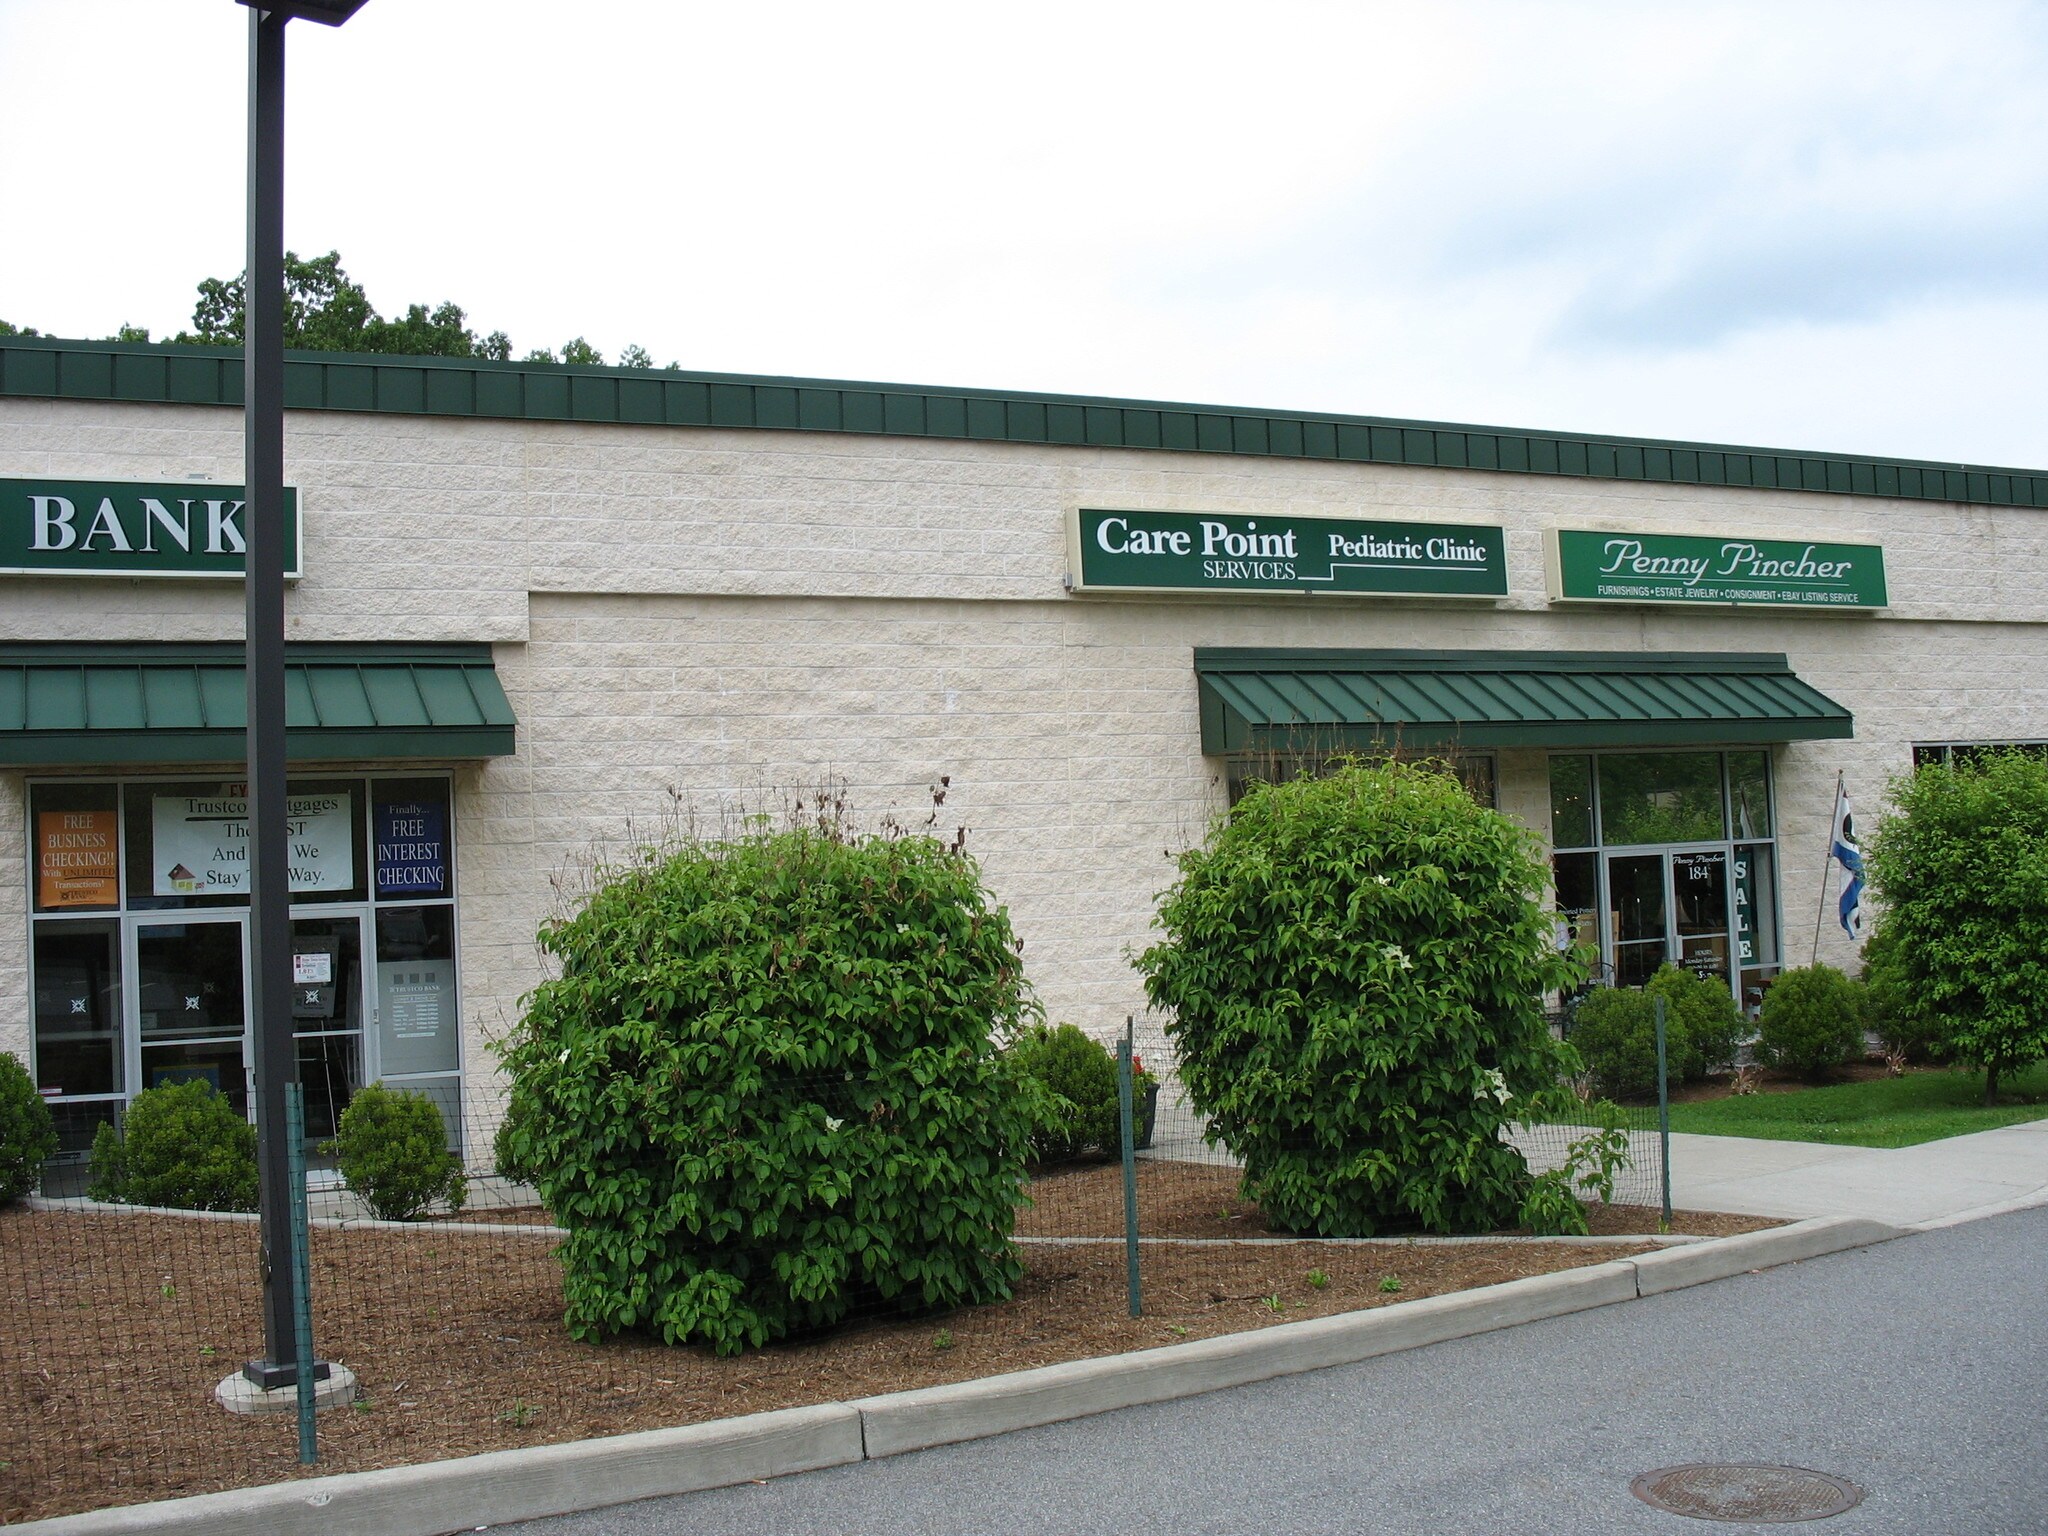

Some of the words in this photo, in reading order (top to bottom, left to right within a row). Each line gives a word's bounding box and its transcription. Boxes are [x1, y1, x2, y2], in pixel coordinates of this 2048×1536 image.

[27, 495, 247, 553] BANK
[1097, 517, 1191, 556] Care
[1199, 521, 1298, 559] Point
[1328, 534, 1423, 560] Pediatric
[1426, 537, 1487, 562] Clinic
[1203, 560, 1296, 580] SERVICES
[1599, 539, 1710, 586] Penny
[1716, 543, 1853, 579] Pincher
[1597, 585, 1650, 597] FURNISHINGS
[1655, 586, 1684, 598] ESTATE
[1685, 588, 1719, 599] JEWELRY
[1724, 589, 1777, 601] CONSIGNMENT
[1782, 591, 1801, 601] EBAY
[1801, 591, 1829, 602] LISTING
[1829, 593, 1859, 603] SERVICE
[185, 798, 247, 813] Trustco
[287, 799, 338, 815] tgages
[389, 804, 430, 816] Finally...
[64, 814, 94, 829] FREE
[392, 819, 425, 837] FREE
[48, 833, 107, 849] BUSINESS
[43, 851, 114, 867] CHECKING!!
[212, 846, 245, 861] And
[294, 844, 319, 858] We
[378, 843, 440, 861] INTEREST
[43, 869, 62, 877] With
[64, 868, 115, 877] UNLIMITED
[206, 869, 241, 888] Stay
[287, 867, 325, 884] Way.
[377, 866, 444, 891] CHECKING
[1688, 866, 1709, 880] 184
[54, 880, 105, 889] Transactions!
[1734, 861, 1753, 959] SALE
